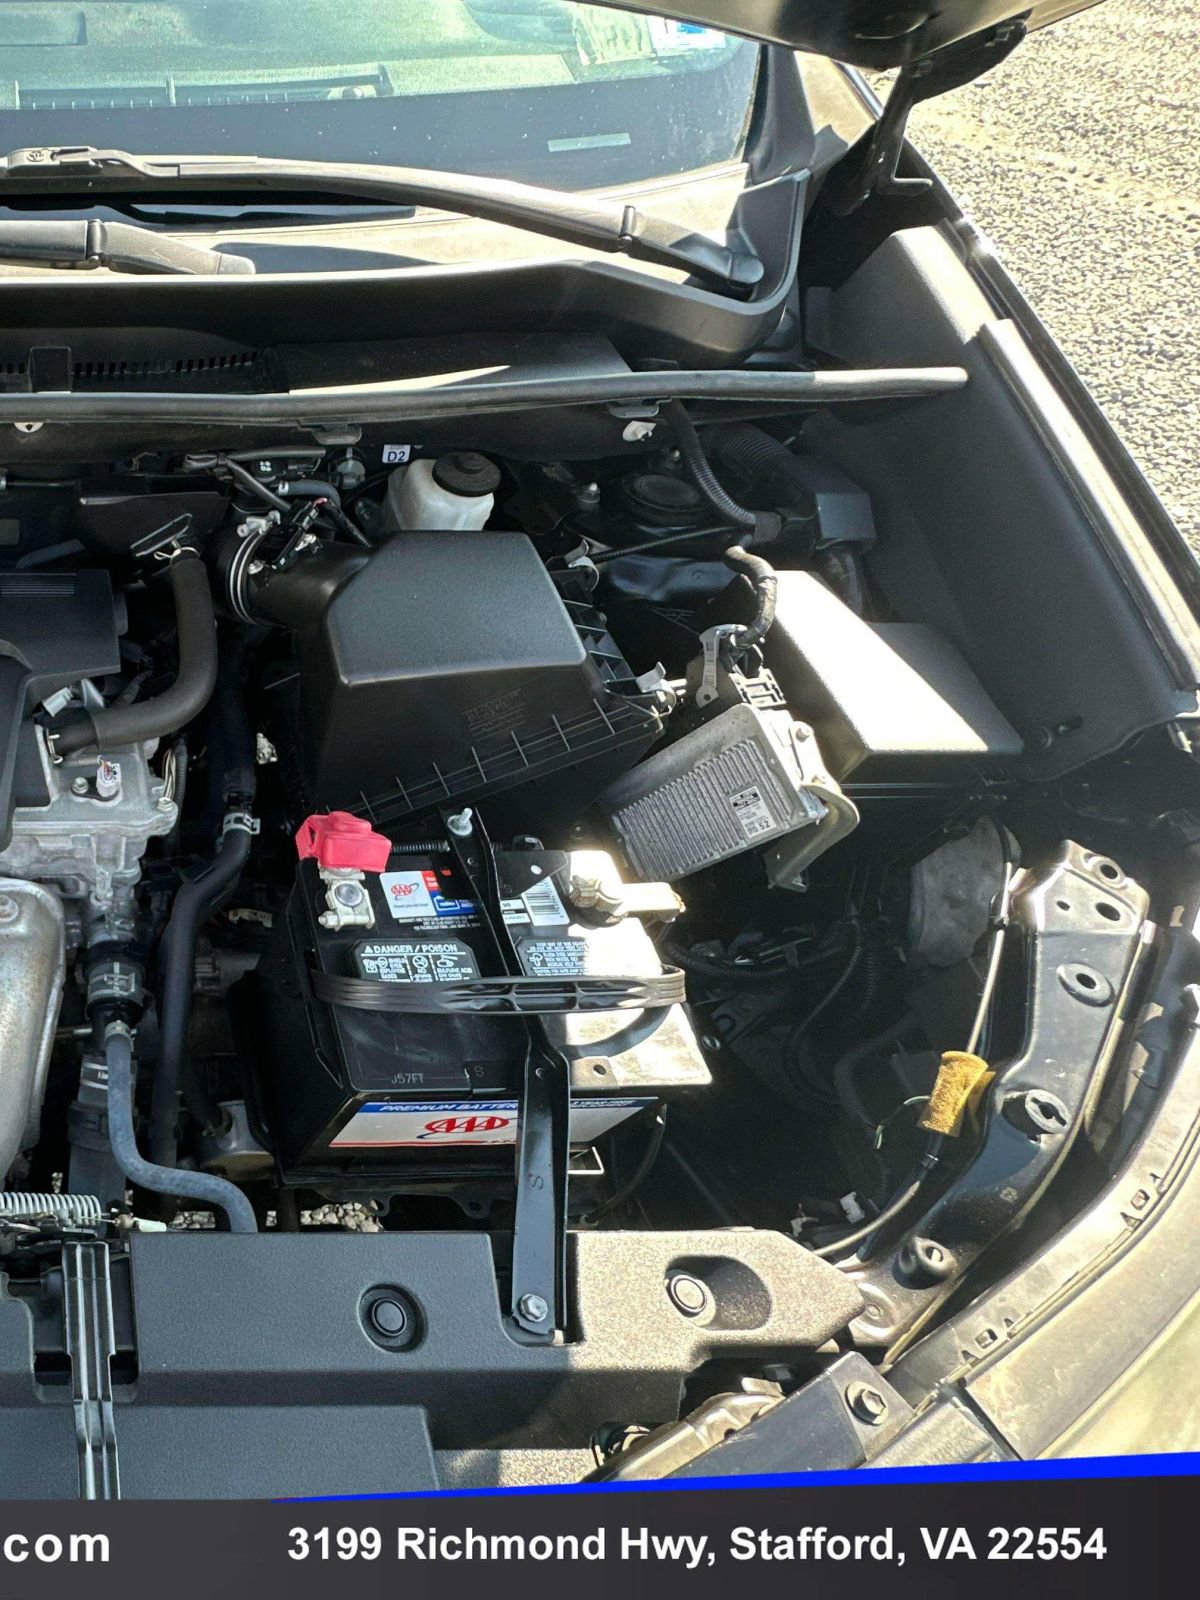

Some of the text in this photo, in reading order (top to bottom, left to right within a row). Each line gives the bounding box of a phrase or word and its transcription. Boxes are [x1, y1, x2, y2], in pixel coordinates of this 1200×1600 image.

[388, 450, 406, 462] D2
[373, 944, 414, 953] DANGER
[421, 943, 458, 953] POISON
[380, 1102, 518, 1112] PREMIUM BATTER
[424, 1116, 510, 1133] AAA
